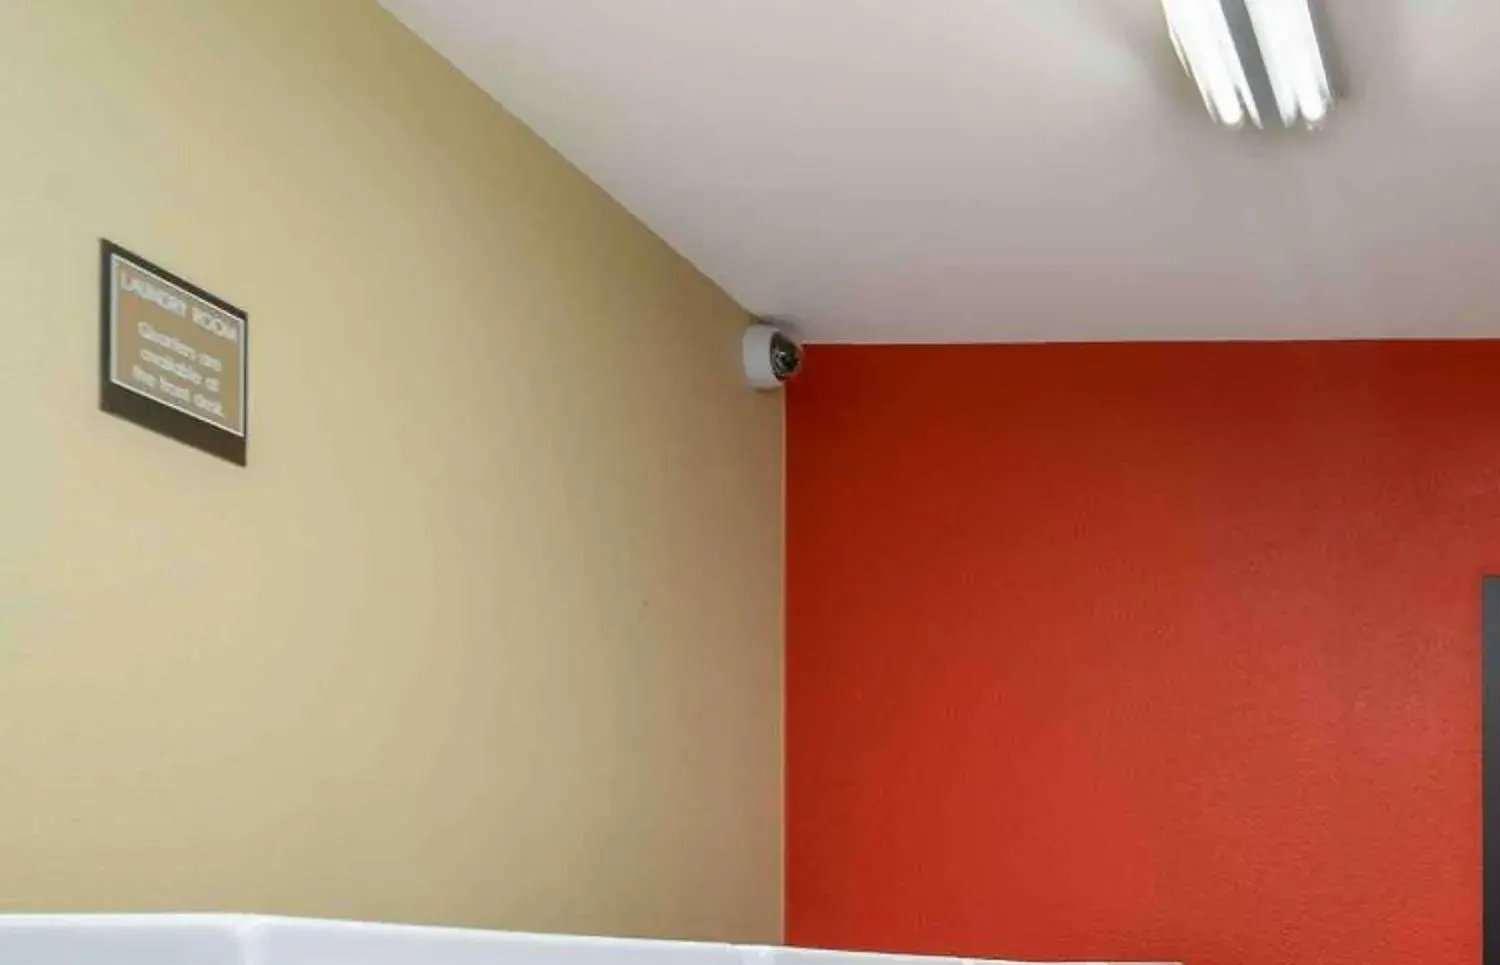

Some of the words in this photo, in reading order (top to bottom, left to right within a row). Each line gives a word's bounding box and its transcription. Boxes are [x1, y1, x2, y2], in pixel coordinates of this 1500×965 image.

[120, 270, 187, 318] LAUNDRY
[191, 306, 238, 342] ROOM
[137, 321, 195, 361] Quarters
[197, 352, 222, 373] are
[140, 348, 202, 386] available
[204, 376, 220, 393] at
[131, 364, 156, 390] the
[159, 374, 191, 401] front
